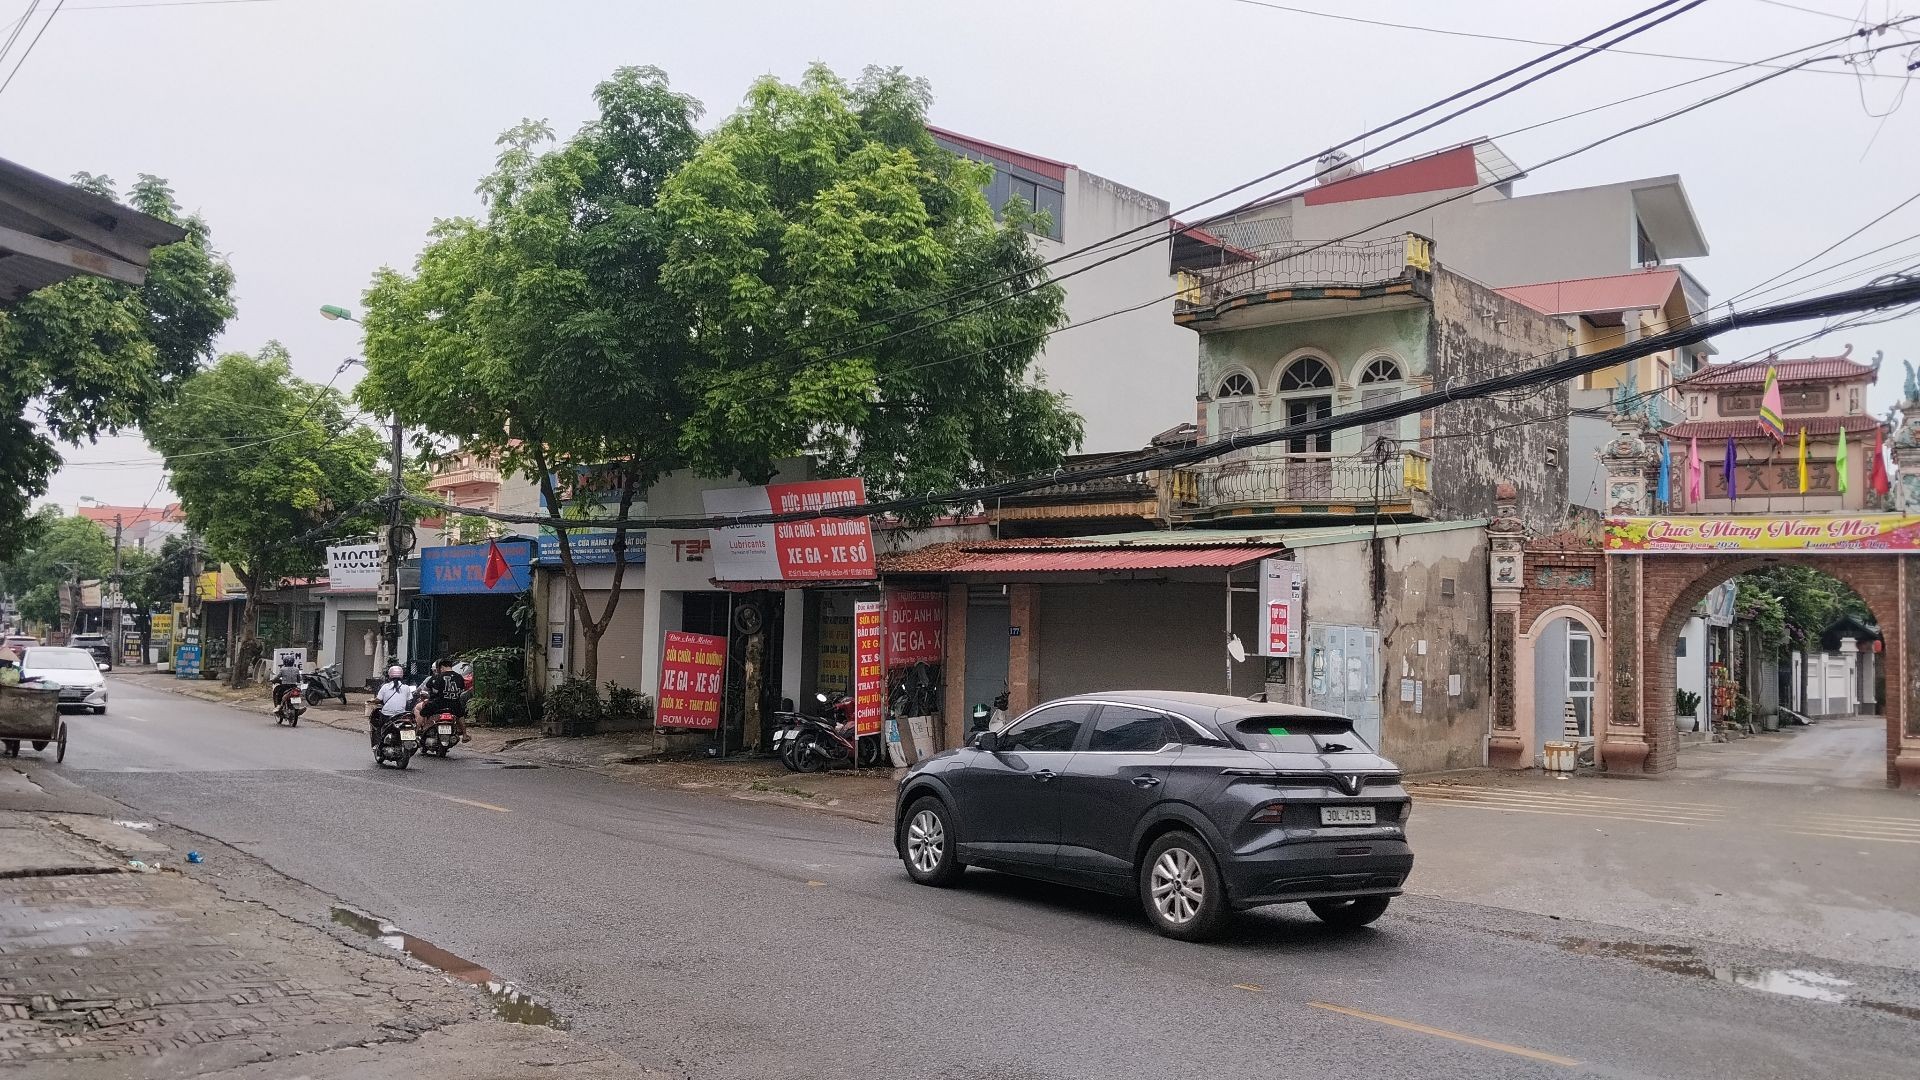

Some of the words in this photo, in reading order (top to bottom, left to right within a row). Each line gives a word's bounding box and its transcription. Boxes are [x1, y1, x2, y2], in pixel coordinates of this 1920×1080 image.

[802, 493, 821, 511] ANH
[823, 490, 856, 508] MOTOR
[1647, 520, 1694, 541] Chúc
[729, 539, 766, 549] Lubricants
[787, 548, 804, 564] XE
[805, 548, 822, 563] GA
[830, 546, 848, 563] XE
[851, 539, 867, 563] SỐ
[333, 550, 381, 568] MOCH
[893, 606, 912, 624] ĐỨC
[914, 608, 932, 623] ANH
[1010, 627, 1020, 635] 177
[861, 639, 871, 649] XE
[872, 639, 881, 648] G
[892, 631, 907, 652] XE
[909, 630, 926, 651] GA
[933, 630, 941, 650] X
[861, 654, 872, 663] XE
[873, 653, 881, 662] S
[663, 669, 676, 690] XE
[677, 670, 688, 691] GA
[695, 672, 708, 693] XE
[708, 667, 722, 694] SỐ
[860, 666, 870, 677] XE
[675, 698, 684, 709] XE
